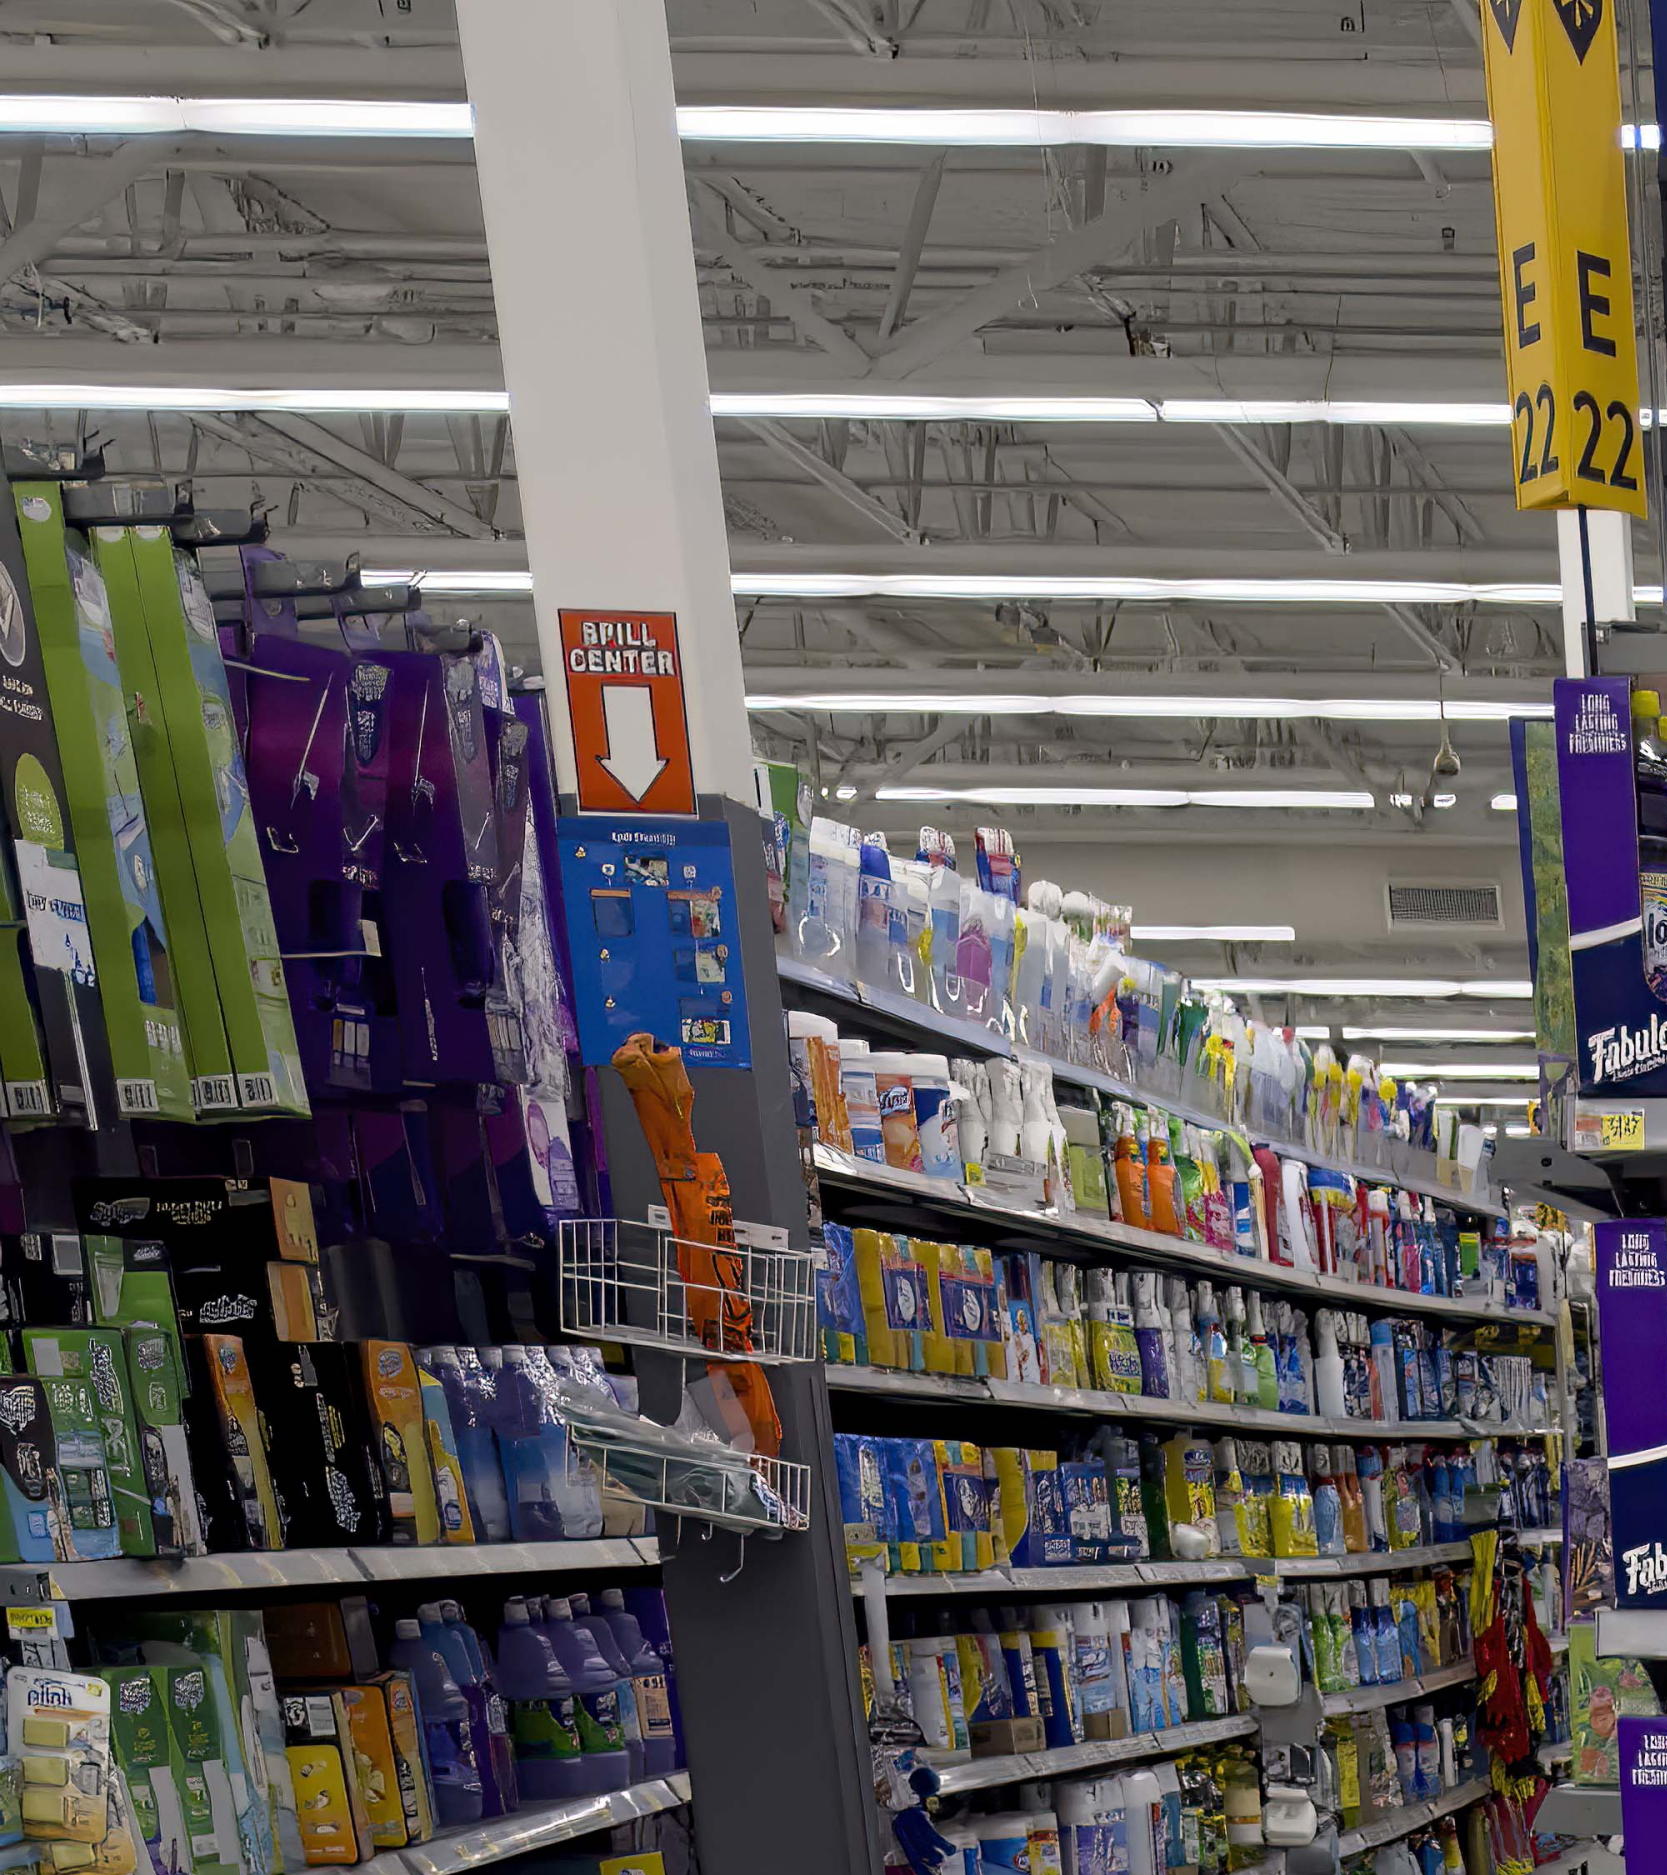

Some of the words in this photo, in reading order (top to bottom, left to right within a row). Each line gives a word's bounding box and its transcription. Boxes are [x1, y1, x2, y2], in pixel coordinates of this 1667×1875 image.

[1513, 241, 1541, 349] E
[1576, 250, 1617, 357] E
[1516, 383, 1558, 484] 22
[1573, 390, 1638, 491] 22
[569, 648, 676, 676] CENTER
